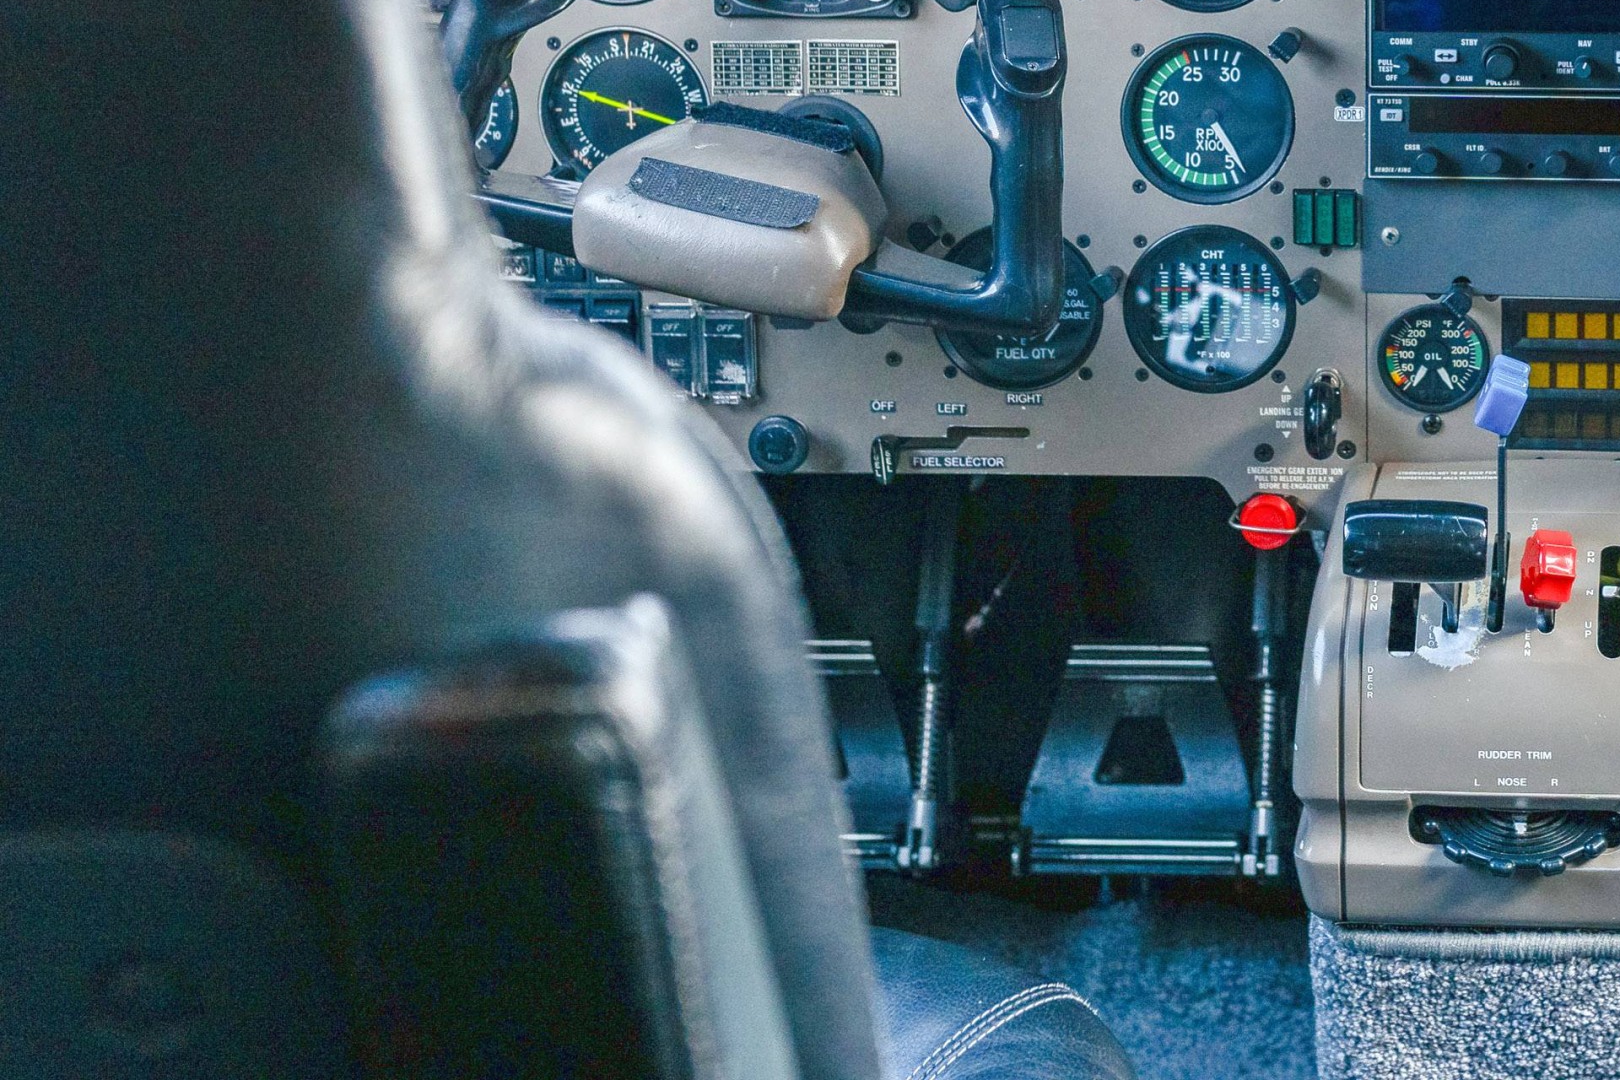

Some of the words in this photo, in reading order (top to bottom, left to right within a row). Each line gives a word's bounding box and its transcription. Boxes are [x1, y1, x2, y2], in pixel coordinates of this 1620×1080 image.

[1182, 67, 1203, 82] 25
[1219, 67, 1240, 82] 30
[1159, 91, 1179, 106] 20
[1336, 108, 1356, 120] XPDR
[1358, 109, 1362, 120] 1
[1159, 125, 1175, 140] 15
[1195, 139, 1224, 152] X100
[1185, 152, 1200, 167] 10
[1224, 155, 1235, 169] 5
[1201, 250, 1224, 260] CHT
[996, 347, 1028, 359] FUEL
[1424, 353, 1442, 361] OIL
[1007, 393, 1042, 404] RIGHT
[1281, 394, 1291, 402] UP
[871, 401, 895, 411] OFF
[937, 404, 965, 414] LEFT
[1259, 407, 1291, 416] LANDING
[1275, 420, 1298, 429] DOWN
[912, 457, 943, 468] FUEL
[945, 456, 1004, 468] SELECTOR
[1247, 466, 1281, 475] EMERGENCY
[1283, 467, 1304, 476] GEAR
[1478, 750, 1522, 760] RUDDER
[1526, 750, 1552, 760] TRIM
[1474, 778, 1480, 786] L
[1497, 777, 1527, 786] NOSE
[1551, 778, 1559, 786] R
